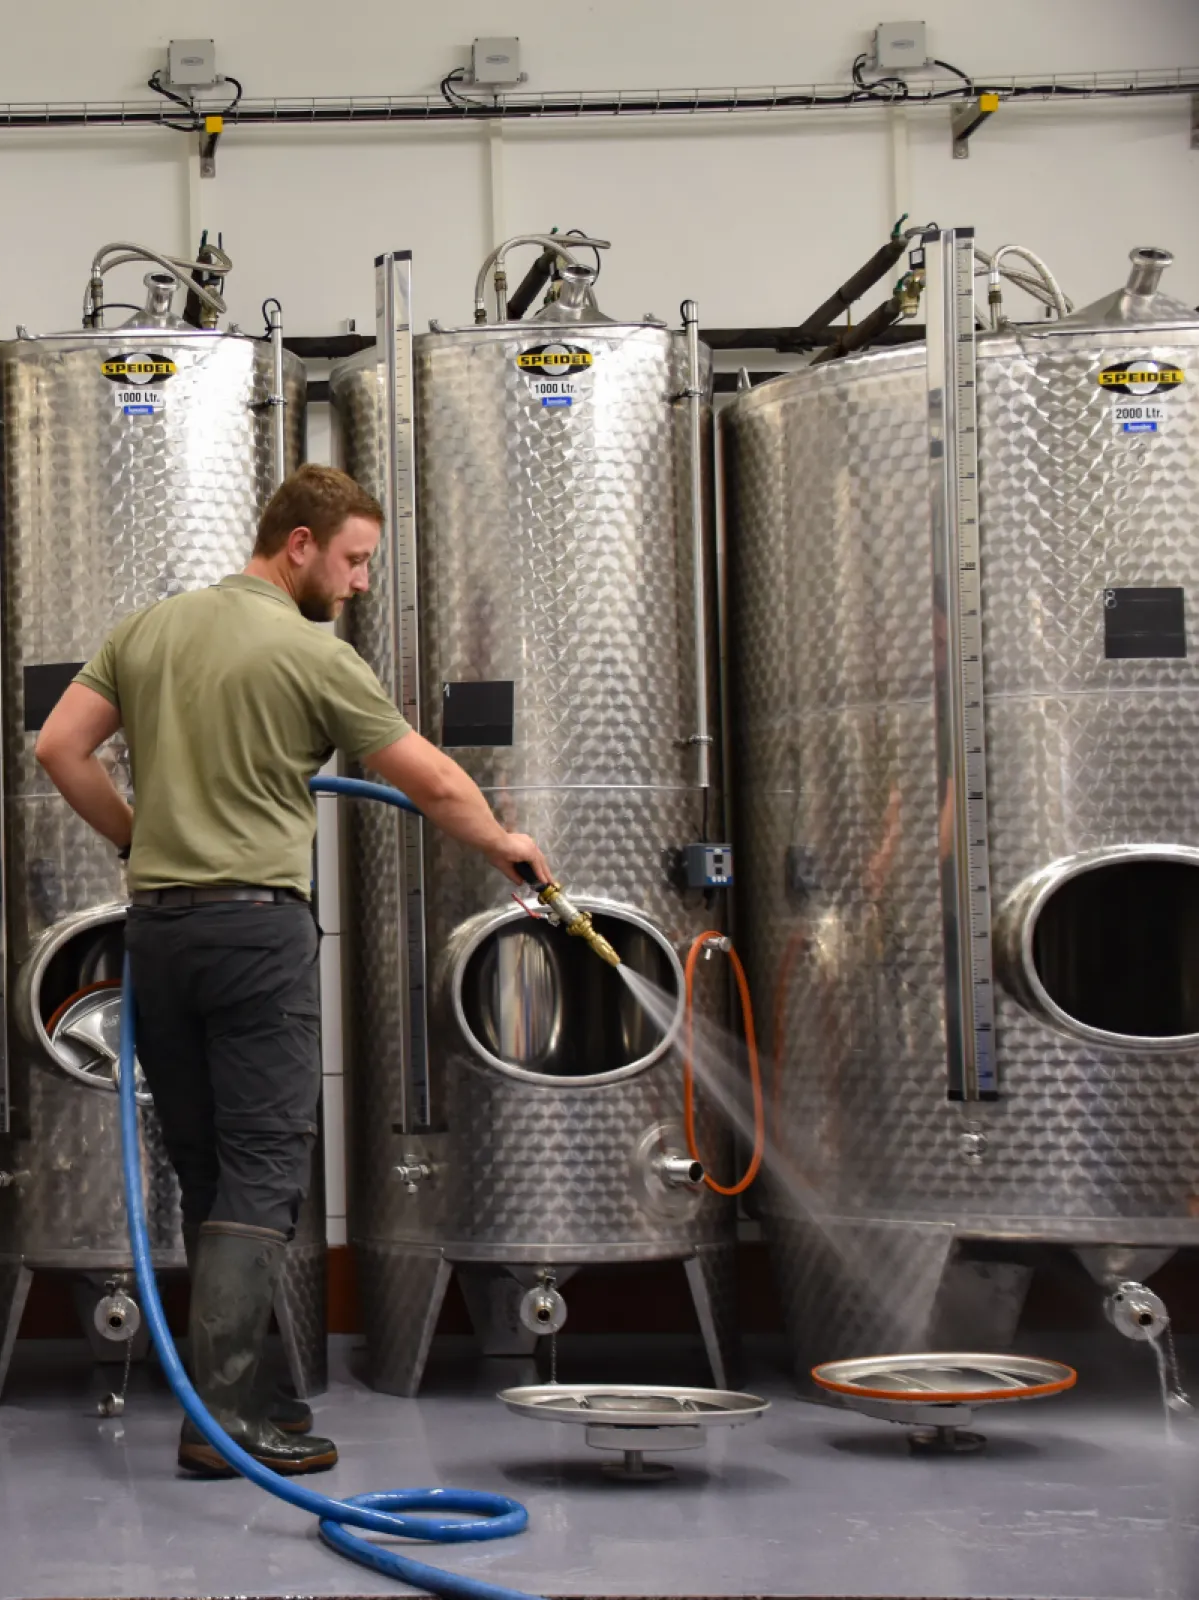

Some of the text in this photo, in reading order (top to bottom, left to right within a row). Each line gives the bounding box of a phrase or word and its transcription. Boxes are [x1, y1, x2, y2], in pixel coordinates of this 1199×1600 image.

[521, 355, 589, 365] SPEIDEL
[105, 363, 173, 373] SPEIDEL
[1102, 372, 1180, 383] SPEIDEL
[535, 383, 577, 393] 1000 Ltr.
[118, 392, 160, 402] 1000 Ltr.
[1116, 407, 1163, 419] 2000 Ltr.
[443, 683, 450, 697] 1
